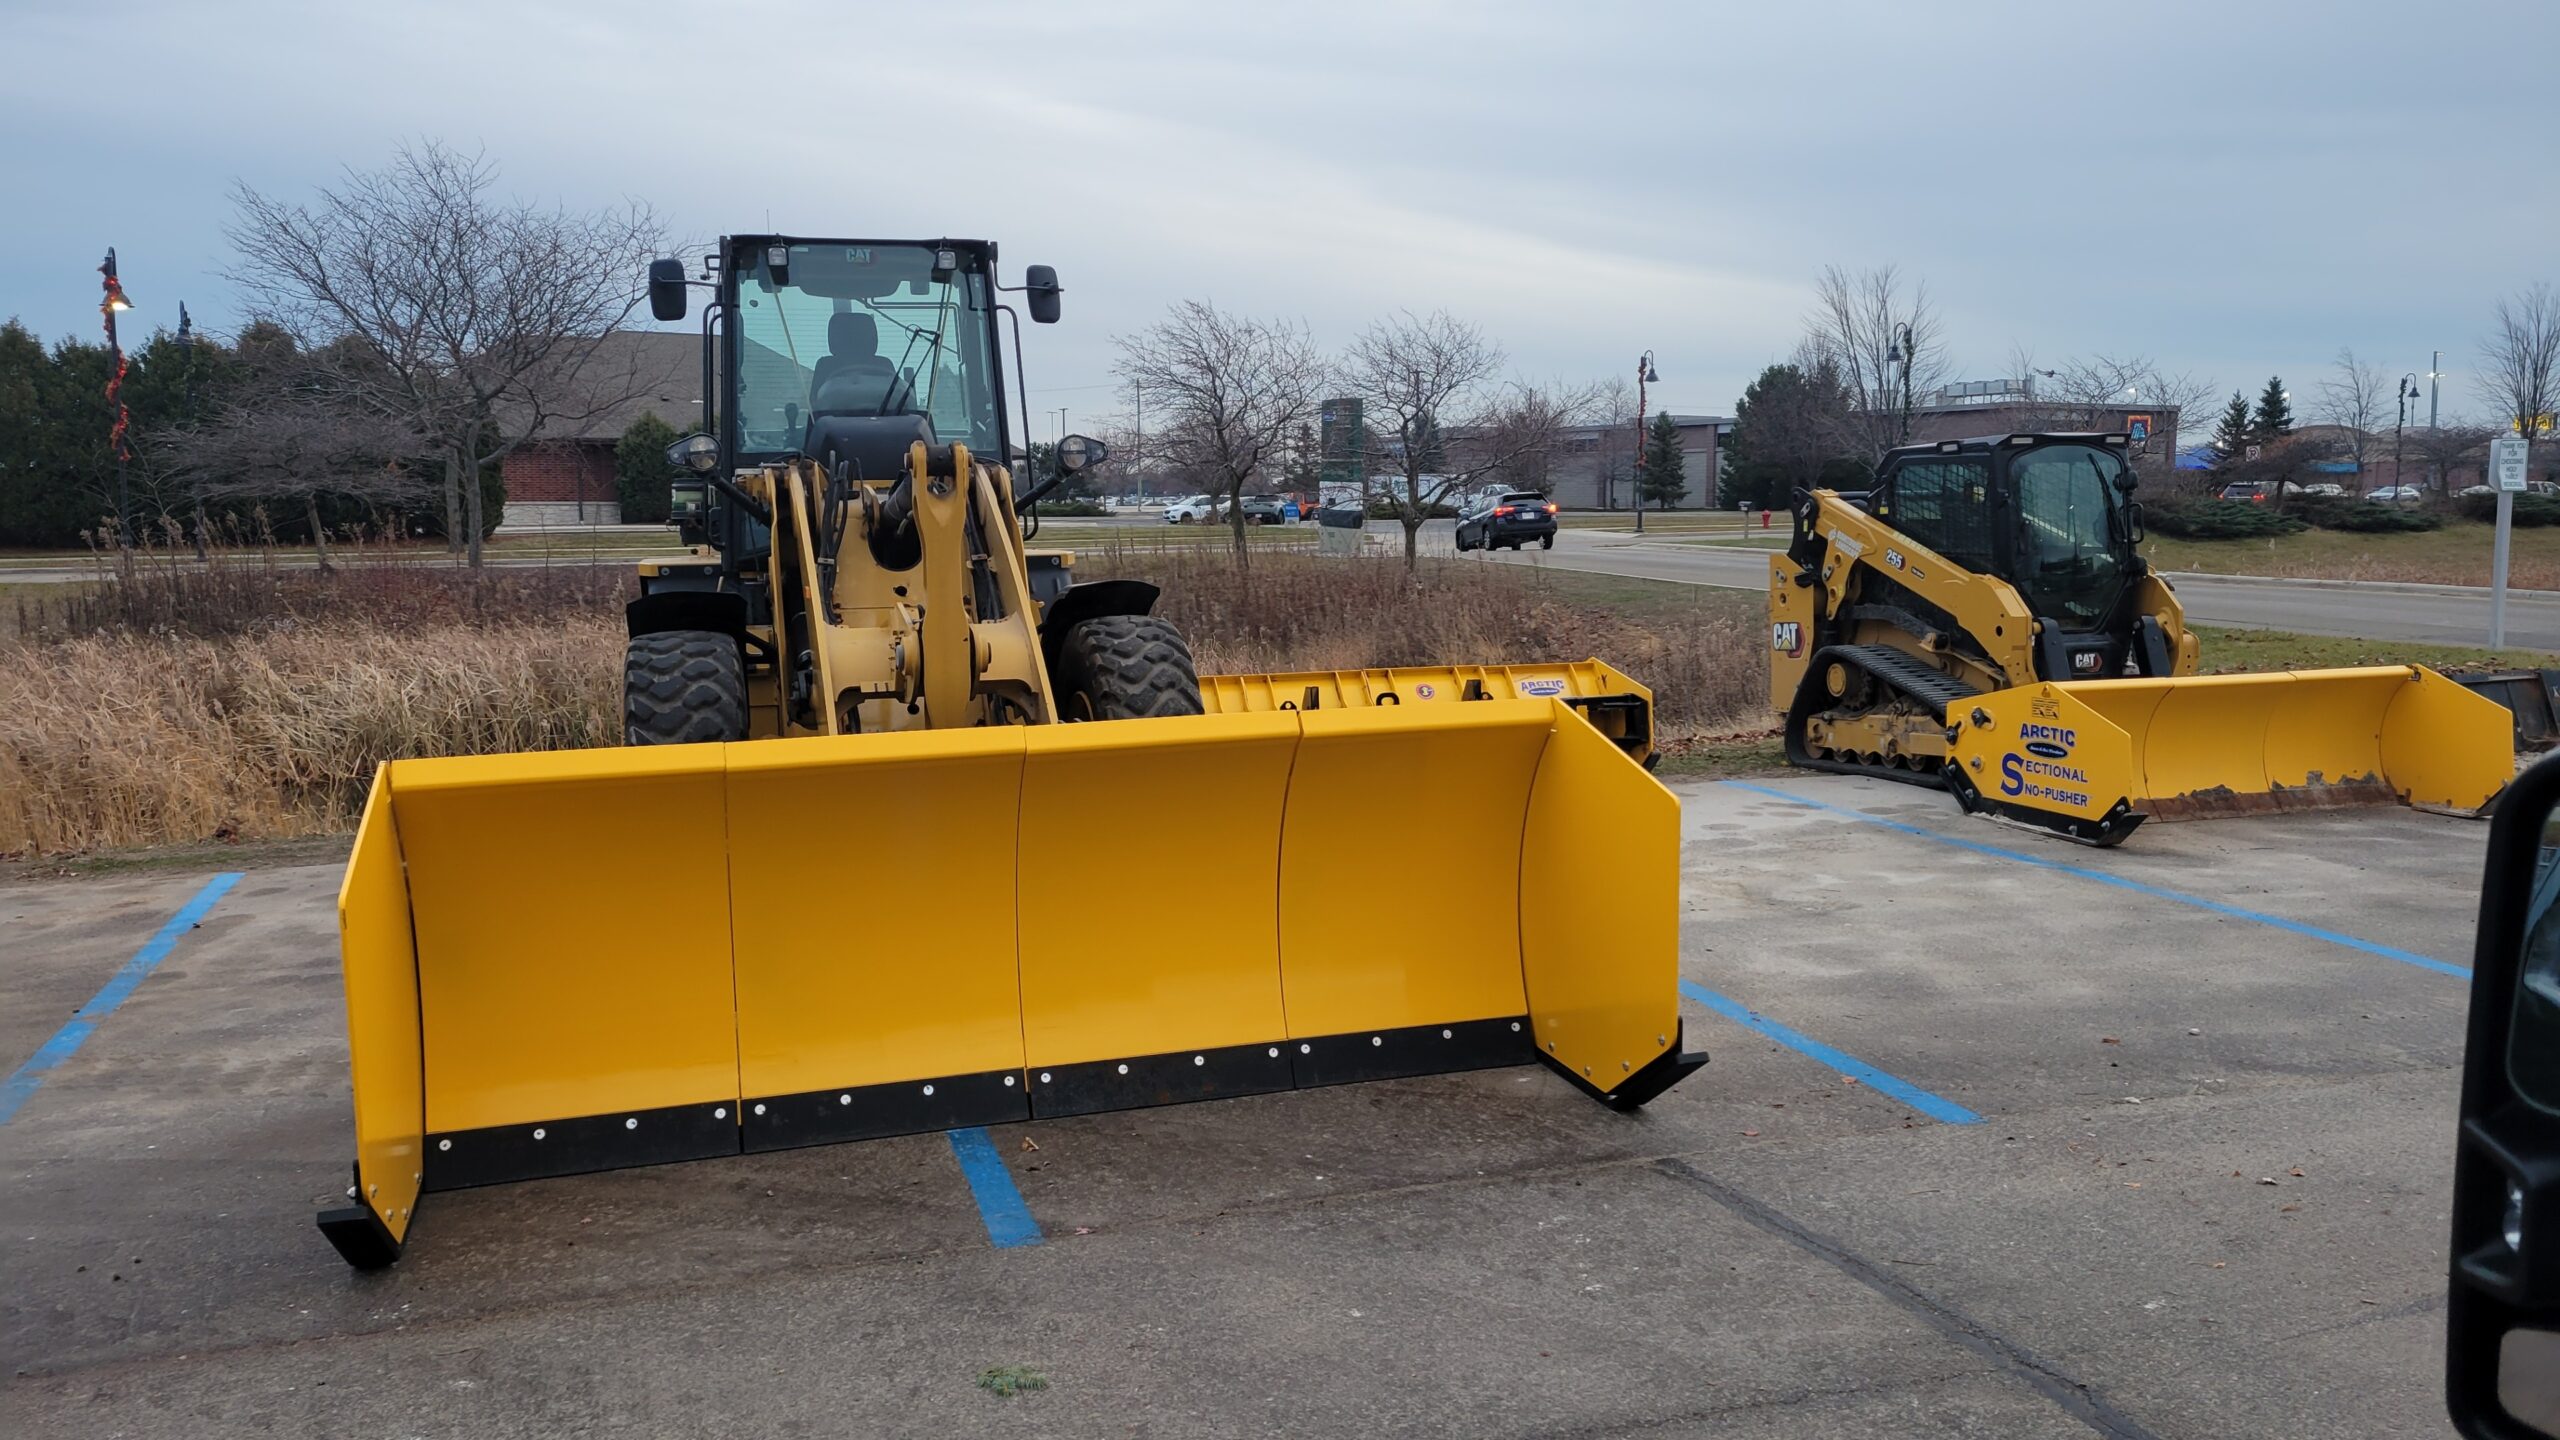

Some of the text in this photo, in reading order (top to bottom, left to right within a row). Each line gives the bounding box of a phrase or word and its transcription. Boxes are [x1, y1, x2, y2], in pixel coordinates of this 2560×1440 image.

[846, 249, 871, 264] CAT
[1886, 548, 1903, 569] 255
[1773, 623, 1798, 650] CAT
[2075, 653, 2096, 668] CAT
[1521, 680, 1565, 692] ARCTIC
[2020, 723, 2075, 747] ARCTIC
